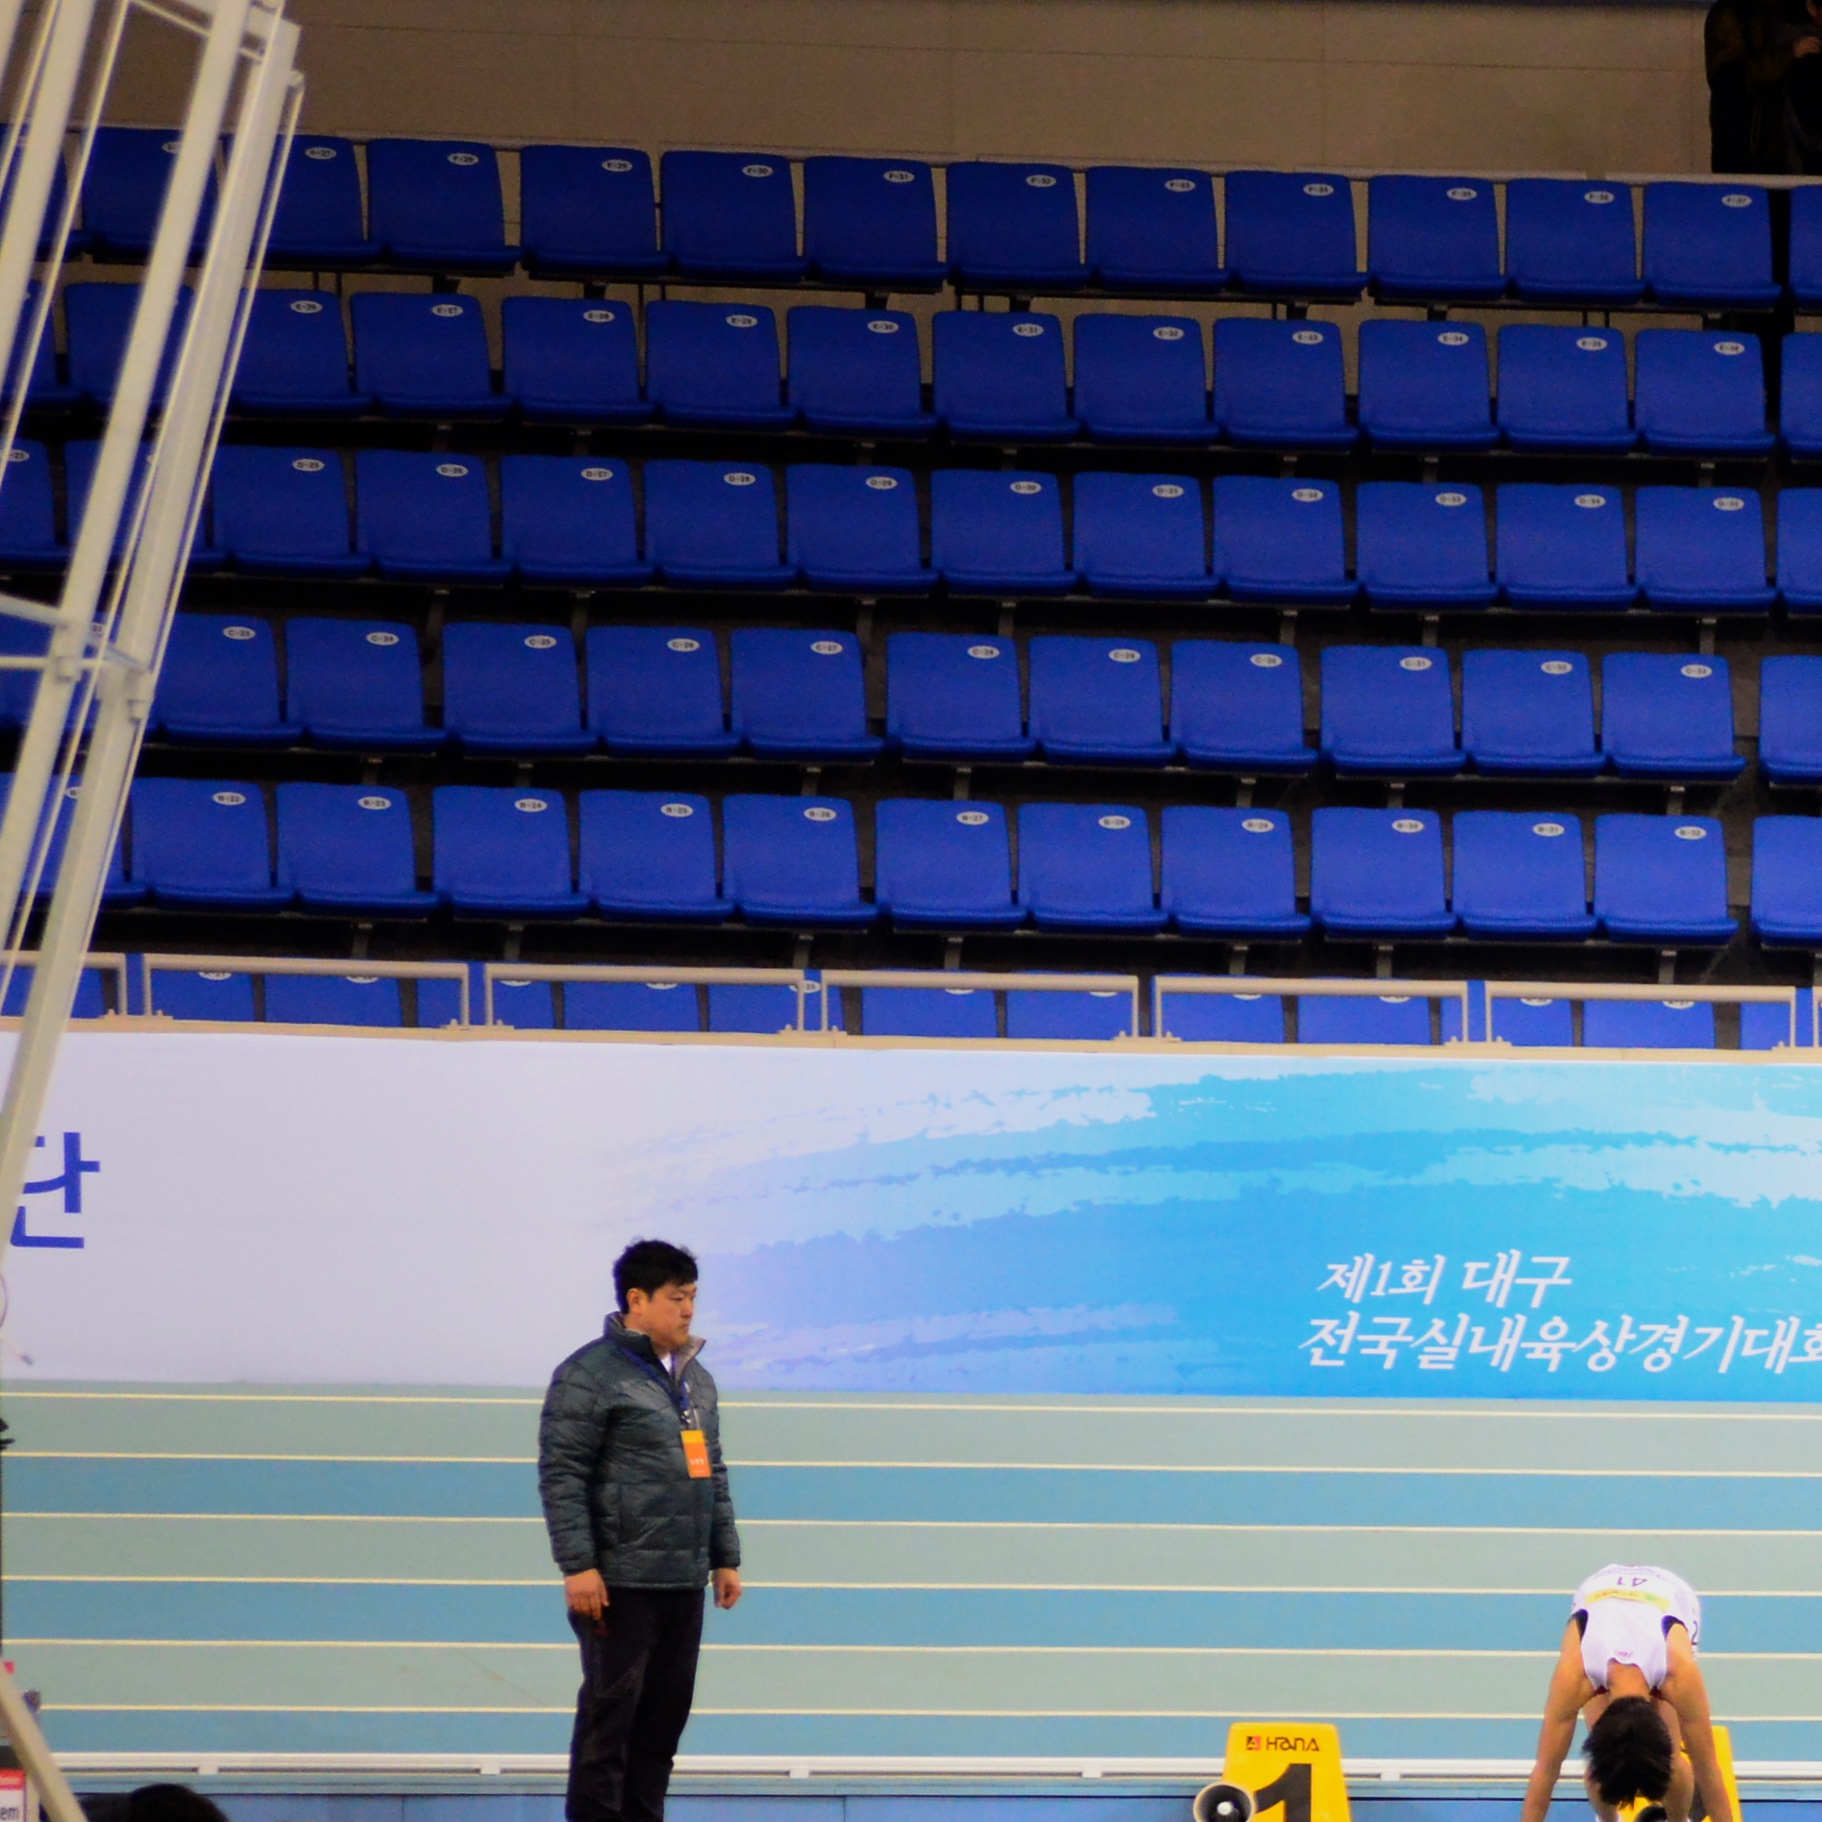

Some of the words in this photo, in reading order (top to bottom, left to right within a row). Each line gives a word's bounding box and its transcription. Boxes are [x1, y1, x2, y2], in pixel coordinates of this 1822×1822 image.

[1317, 1251, 1446, 1305] 제1회
[1462, 1247, 1573, 1309] 대구
[1616, 1575, 1649, 1588] 41
